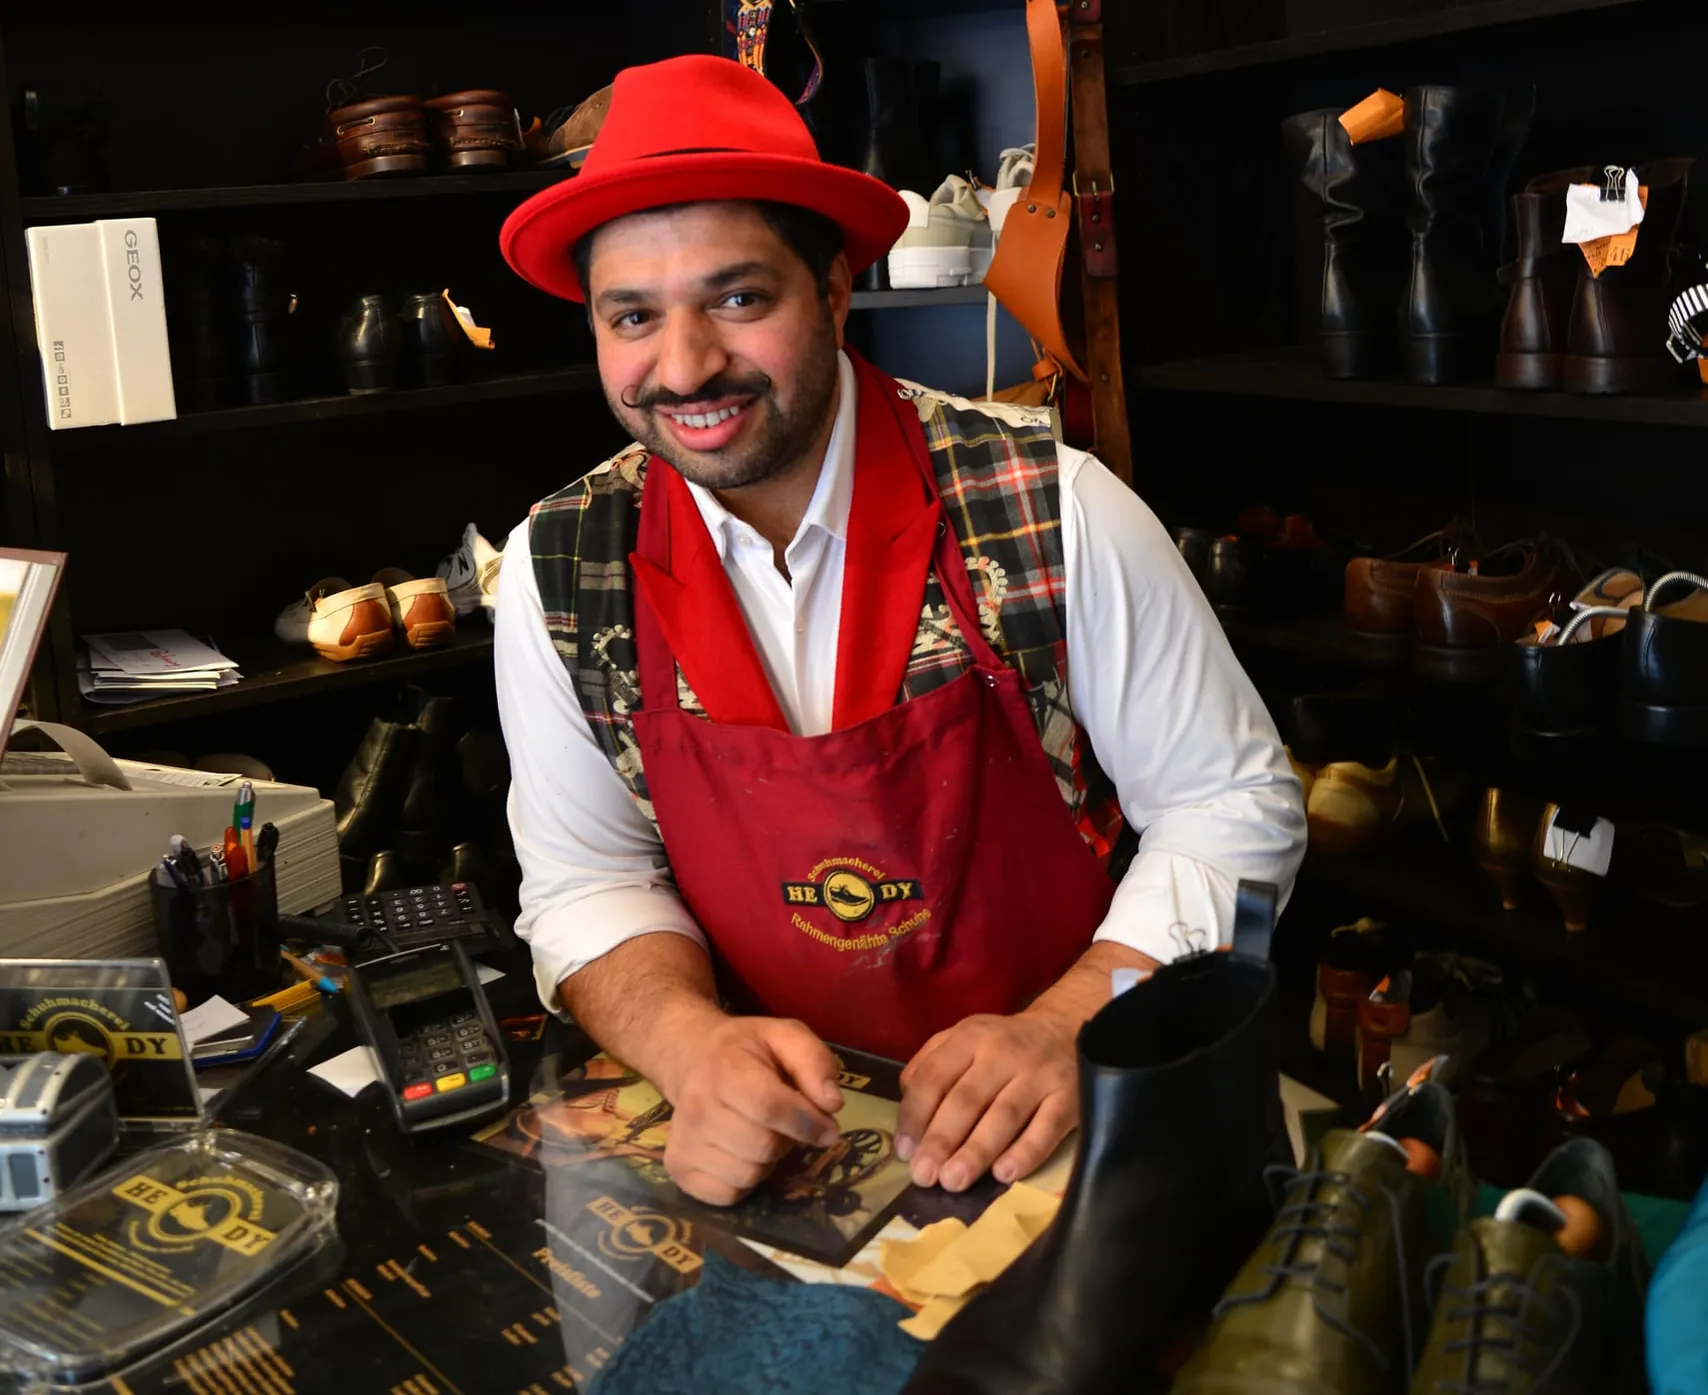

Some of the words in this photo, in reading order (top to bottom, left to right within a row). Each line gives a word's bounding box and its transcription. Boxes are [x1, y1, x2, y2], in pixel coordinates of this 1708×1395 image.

[124, 229, 144, 301] GEOX
[807, 857, 886, 882] Schuhmacherei
[787, 886, 818, 902] HE
[880, 882, 913, 900] DY
[791, 912, 889, 952] Rahmengenähte
[888, 908, 932, 937] Schuhe
[19, 997, 131, 1031] Schuhmacherei
[124, 1037, 168, 1055] DY
[124, 1181, 168, 1205] HE
[222, 1226, 272, 1249] DY
[596, 1201, 622, 1221] HE
[662, 1246, 693, 1266] DY
